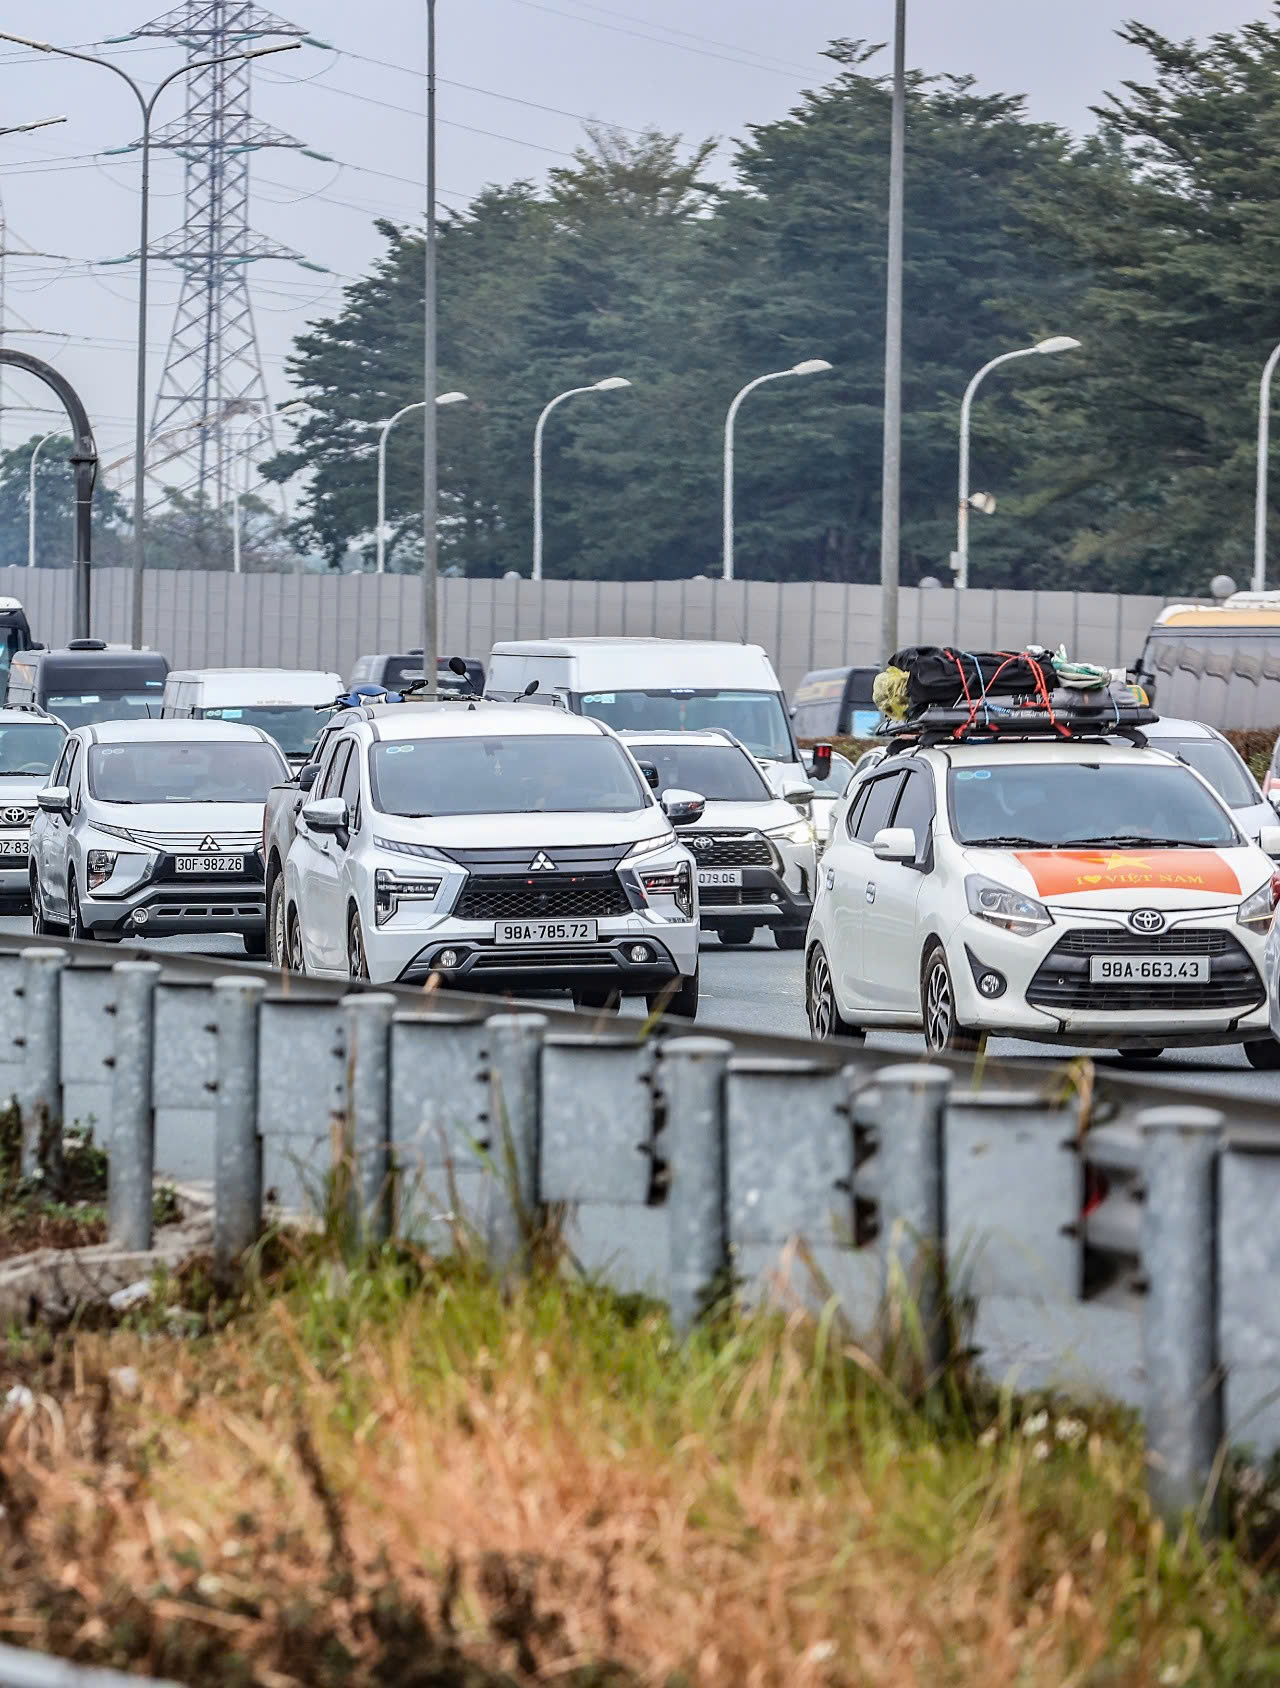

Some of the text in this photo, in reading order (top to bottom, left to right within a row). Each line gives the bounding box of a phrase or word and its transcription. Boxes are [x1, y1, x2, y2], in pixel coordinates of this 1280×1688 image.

[178, 858, 242, 871] 30F-982.26
[1160, 874, 1205, 884] NAM
[504, 924, 589, 940] 98A-785.72
[1101, 962, 1200, 977] 98A-663.43
